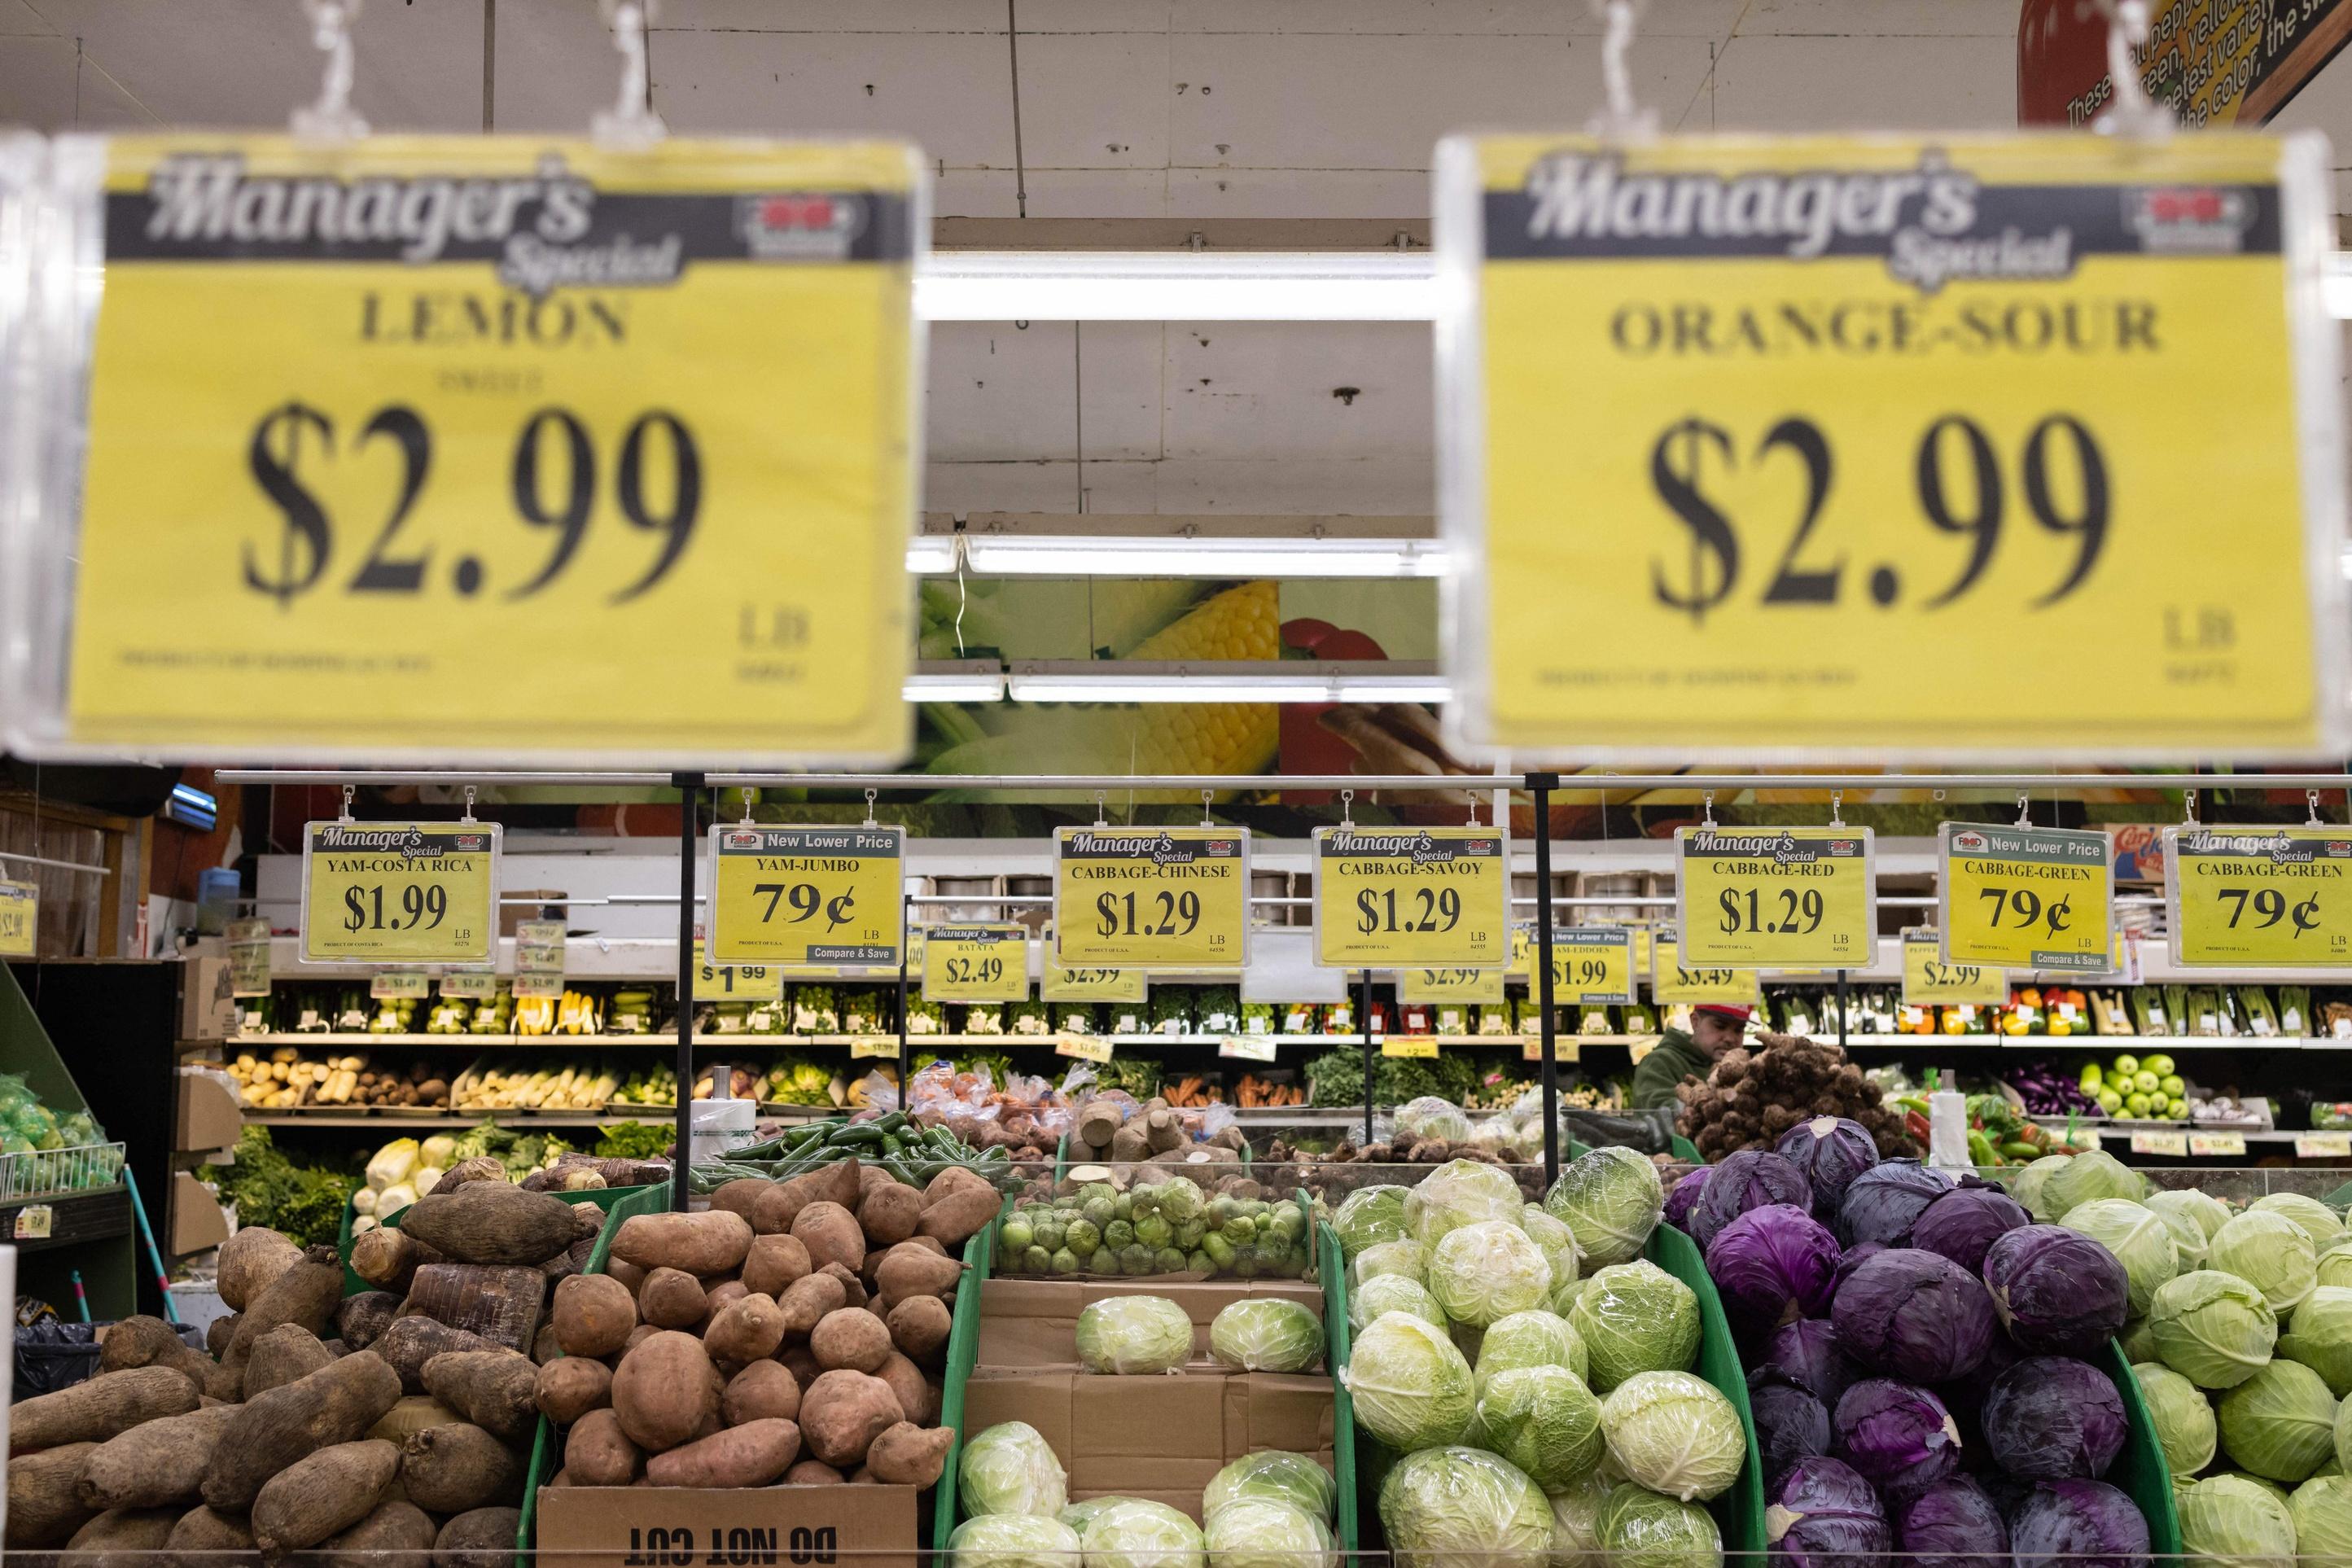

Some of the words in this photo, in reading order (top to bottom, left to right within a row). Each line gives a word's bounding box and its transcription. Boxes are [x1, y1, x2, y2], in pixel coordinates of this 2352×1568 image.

[2067, 74, 2112, 129] These
[2151, 0, 2203, 59] pepp
[2140, 48, 2183, 94] reen,
[2213, 46, 2260, 115] color,
[2267, 9, 2297, 56] the
[150, 155, 593, 259] Manager's
[1529, 152, 1978, 256] Manager's
[360, 291, 629, 345] LEMON
[1610, 302, 2161, 355] ORANGE-SOUR
[242, 400, 704, 612] $2.99
[1649, 414, 2112, 624] $2.99
[323, 827, 422, 851] Manager's
[769, 834, 799, 848] New
[805, 834, 849, 848] Lower
[856, 835, 893, 848] Price
[1073, 833, 1172, 856] Manager's
[1332, 832, 1432, 856] Manager's
[1694, 832, 1794, 856] Manager's
[1992, 837, 2020, 852] New
[2025, 839, 2062, 854] Lower
[2068, 842, 2100, 856] Price
[2188, 831, 2291, 855] Manager's
[402, 846, 442, 858] Special
[1153, 852, 1194, 865] Special
[1413, 851, 1453, 864] Special
[1775, 851, 1815, 865] Special
[2272, 851, 2313, 864] Special
[327, 860, 426, 872] YAM-COSTA
[432, 860, 472, 872] RICA
[756, 858, 859, 872] YAM-JUMBO
[1071, 865, 1230, 878] CABBAGE-CHINESE
[1339, 862, 1483, 875] CABBAGE-SAVOY
[1713, 862, 1834, 876] CABBAGE-RED
[1964, 861, 2091, 881] CABBAGE-GREEN
[2197, 862, 2342, 877] CABBAGE-GREEN
[344, 884, 447, 933] $1.99
[752, 883, 855, 933] 79¢
[1097, 891, 1200, 939] $1.29
[1357, 887, 1461, 936] $1.29
[1719, 887, 1823, 935] $1.29
[1979, 888, 2071, 939] 79¢
[2218, 889, 2320, 939] 79¢
[455, 930, 470, 939] LB
[864, 931, 879, 939] LB
[934, 926, 988, 940] Manager's
[1210, 935, 1225, 944] LB
[1470, 932, 1486, 941] LB
[1576, 934, 1601, 942] Lower
[1833, 935, 1849, 944] LB
[2078, 938, 2091, 948] LB
[2331, 935, 2346, 945] LB
[815, 948, 856, 959] Compare
[857, 948, 865, 957] &
[867, 948, 889, 958] Save
[1556, 946, 1610, 954] AM-EDDOES
[2038, 953, 2072, 965] Compare
[2074, 955, 2081, 964] &
[2083, 955, 2101, 965] Save
[947, 958, 1003, 983] $2.49
[1553, 960, 1606, 985] $1.99
[1925, 961, 1980, 986] $2.99
[624, 1527, 694, 1566] CUT
[706, 1527, 777, 1566] NOT
[790, 1526, 837, 1566] DO
